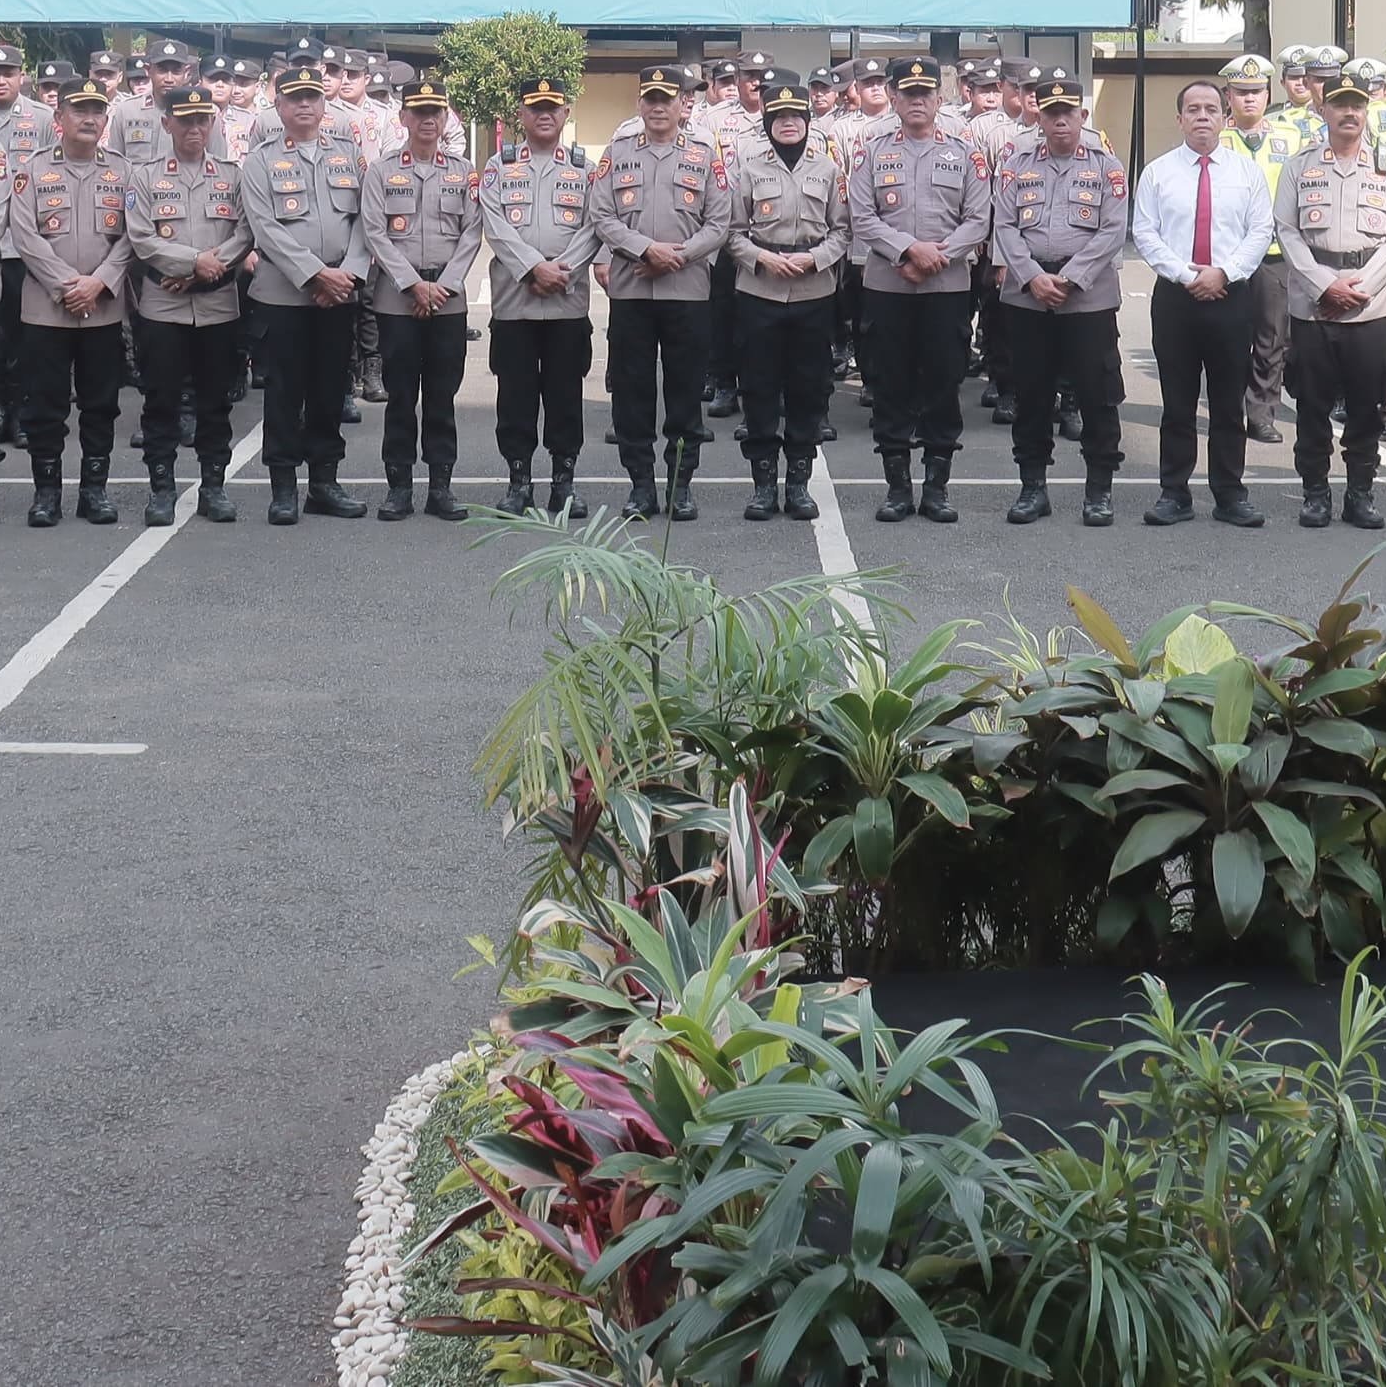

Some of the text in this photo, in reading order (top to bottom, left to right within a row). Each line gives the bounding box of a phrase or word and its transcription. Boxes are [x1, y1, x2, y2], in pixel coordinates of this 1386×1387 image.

[328, 166, 354, 175] POLRI
[614, 161, 641, 172] AMIN
[678, 162, 706, 174] POLRI
[876, 163, 903, 172] JOKO
[935, 163, 962, 173] POLRI
[806, 176, 829, 185] POLRI
[1073, 180, 1102, 190] POLRI
[96, 185, 124, 193] POLRI
[556, 182, 584, 191] POLRI
[152, 192, 181, 200] WIDODO
[209, 192, 235, 201] POLRI
[385, 188, 413, 196] SUYANTO
